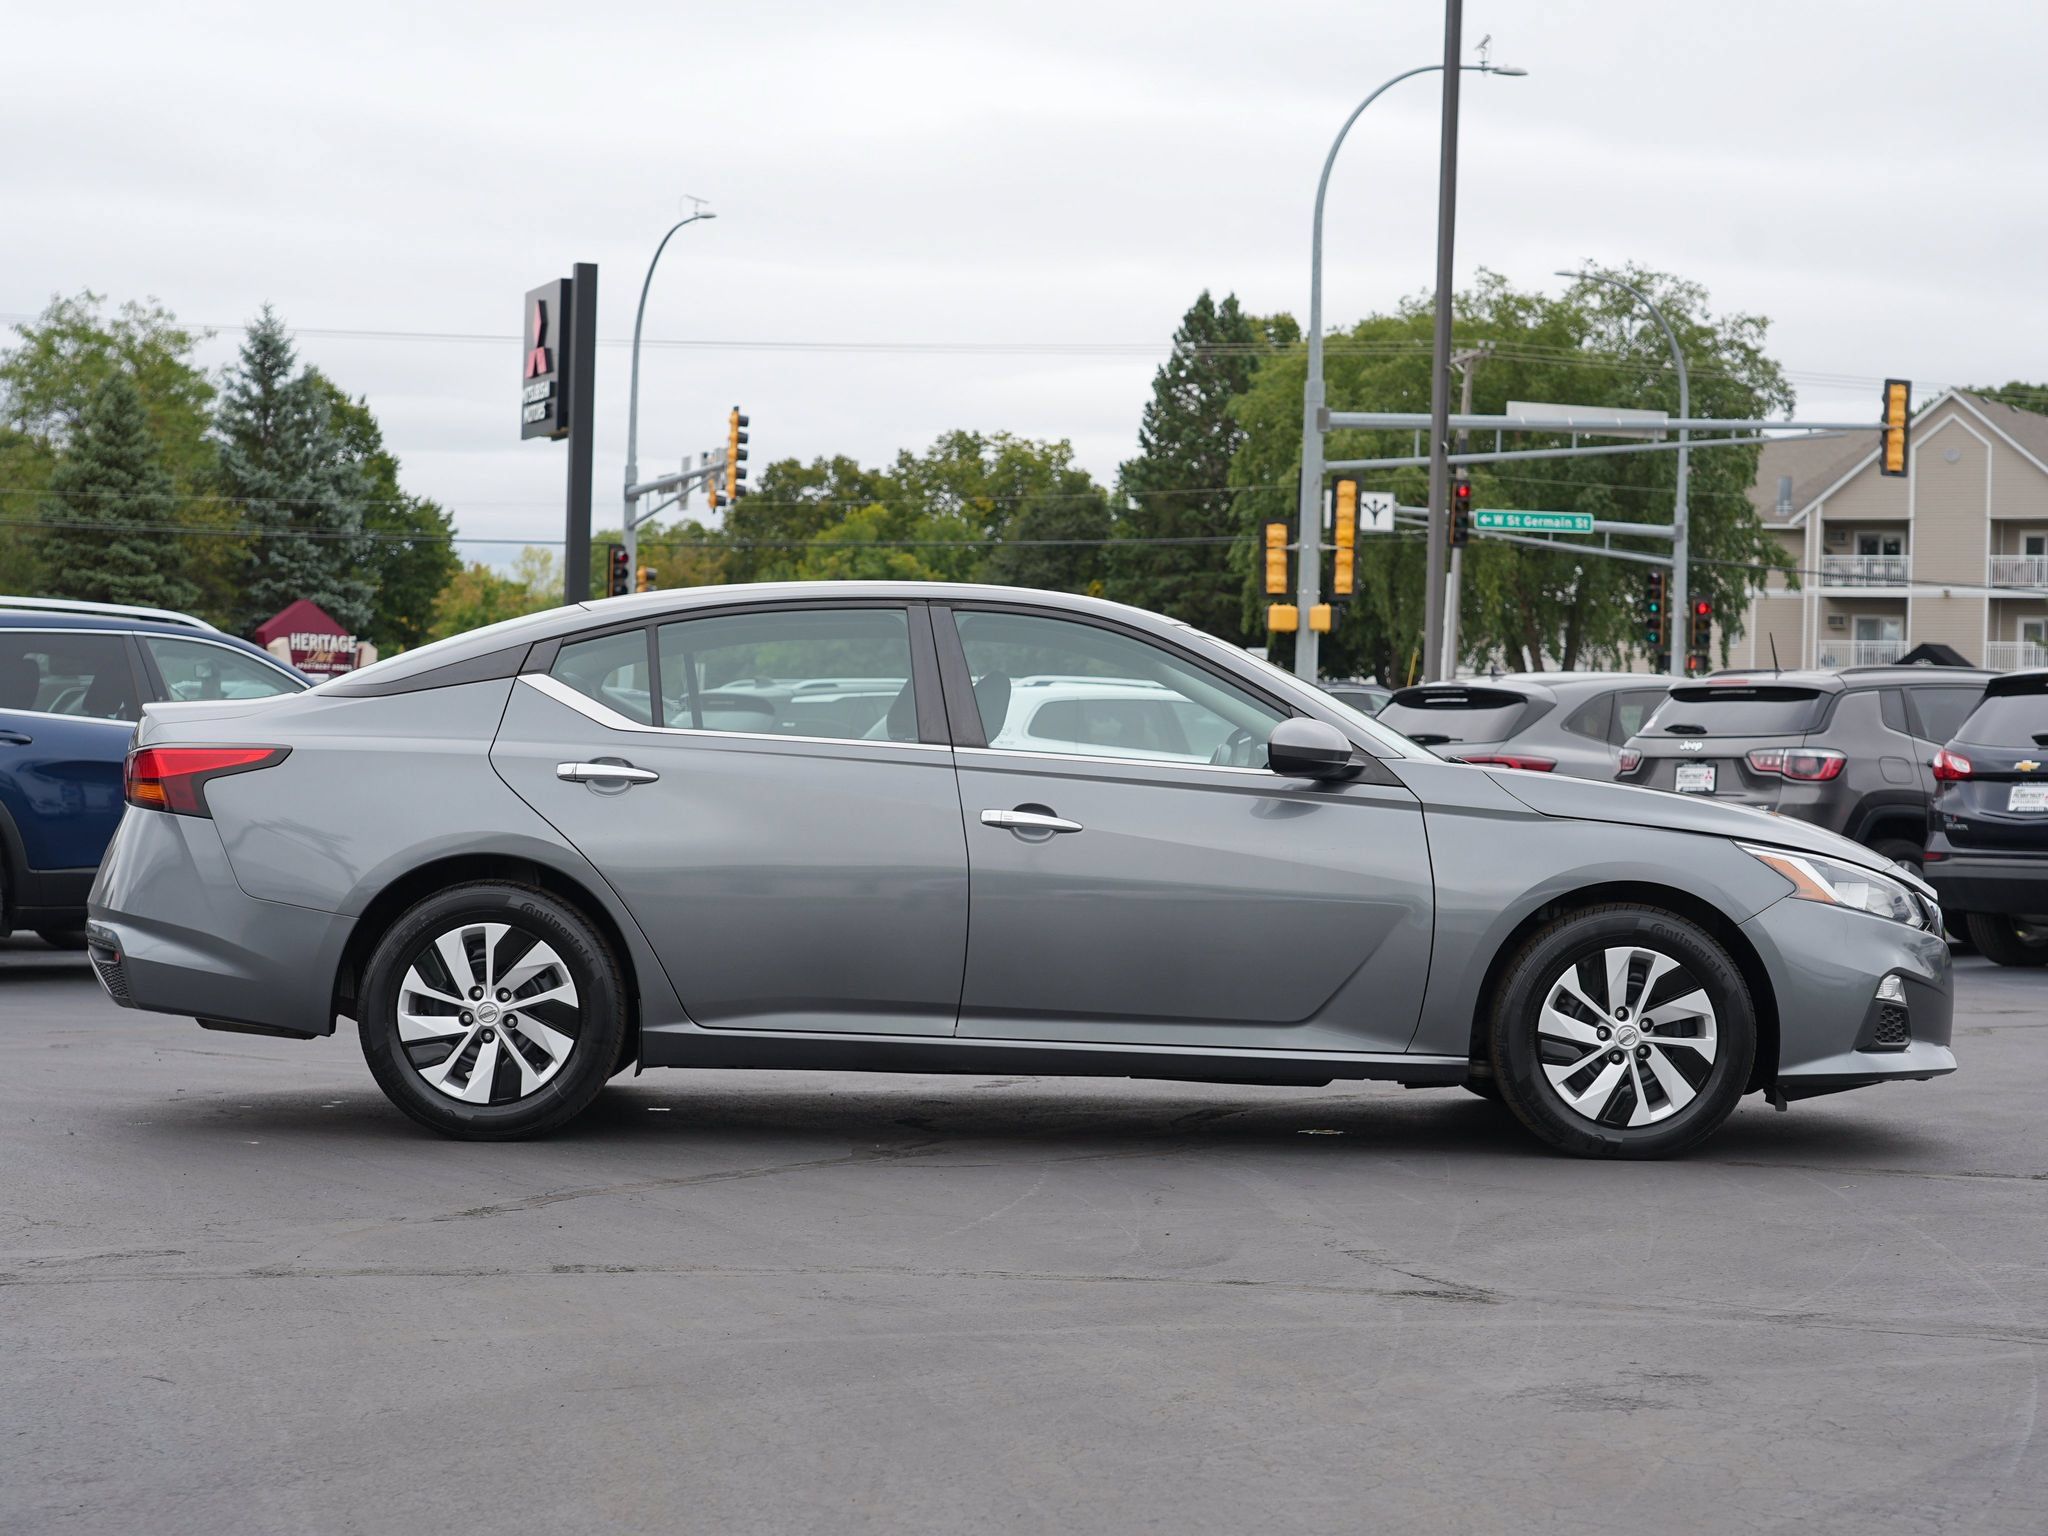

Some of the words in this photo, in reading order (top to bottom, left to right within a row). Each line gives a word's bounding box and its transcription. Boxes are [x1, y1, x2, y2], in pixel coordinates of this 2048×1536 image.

[1493, 514, 1504, 526] W
[1507, 514, 1520, 527] St
[1523, 515, 1573, 529] Germain
[1575, 517, 1589, 530] St
[290, 632, 358, 654] HERITAGE
[1679, 740, 1703, 752] Jeep
[519, 902, 590, 955] Continental
[1650, 922, 1722, 971] Continental
